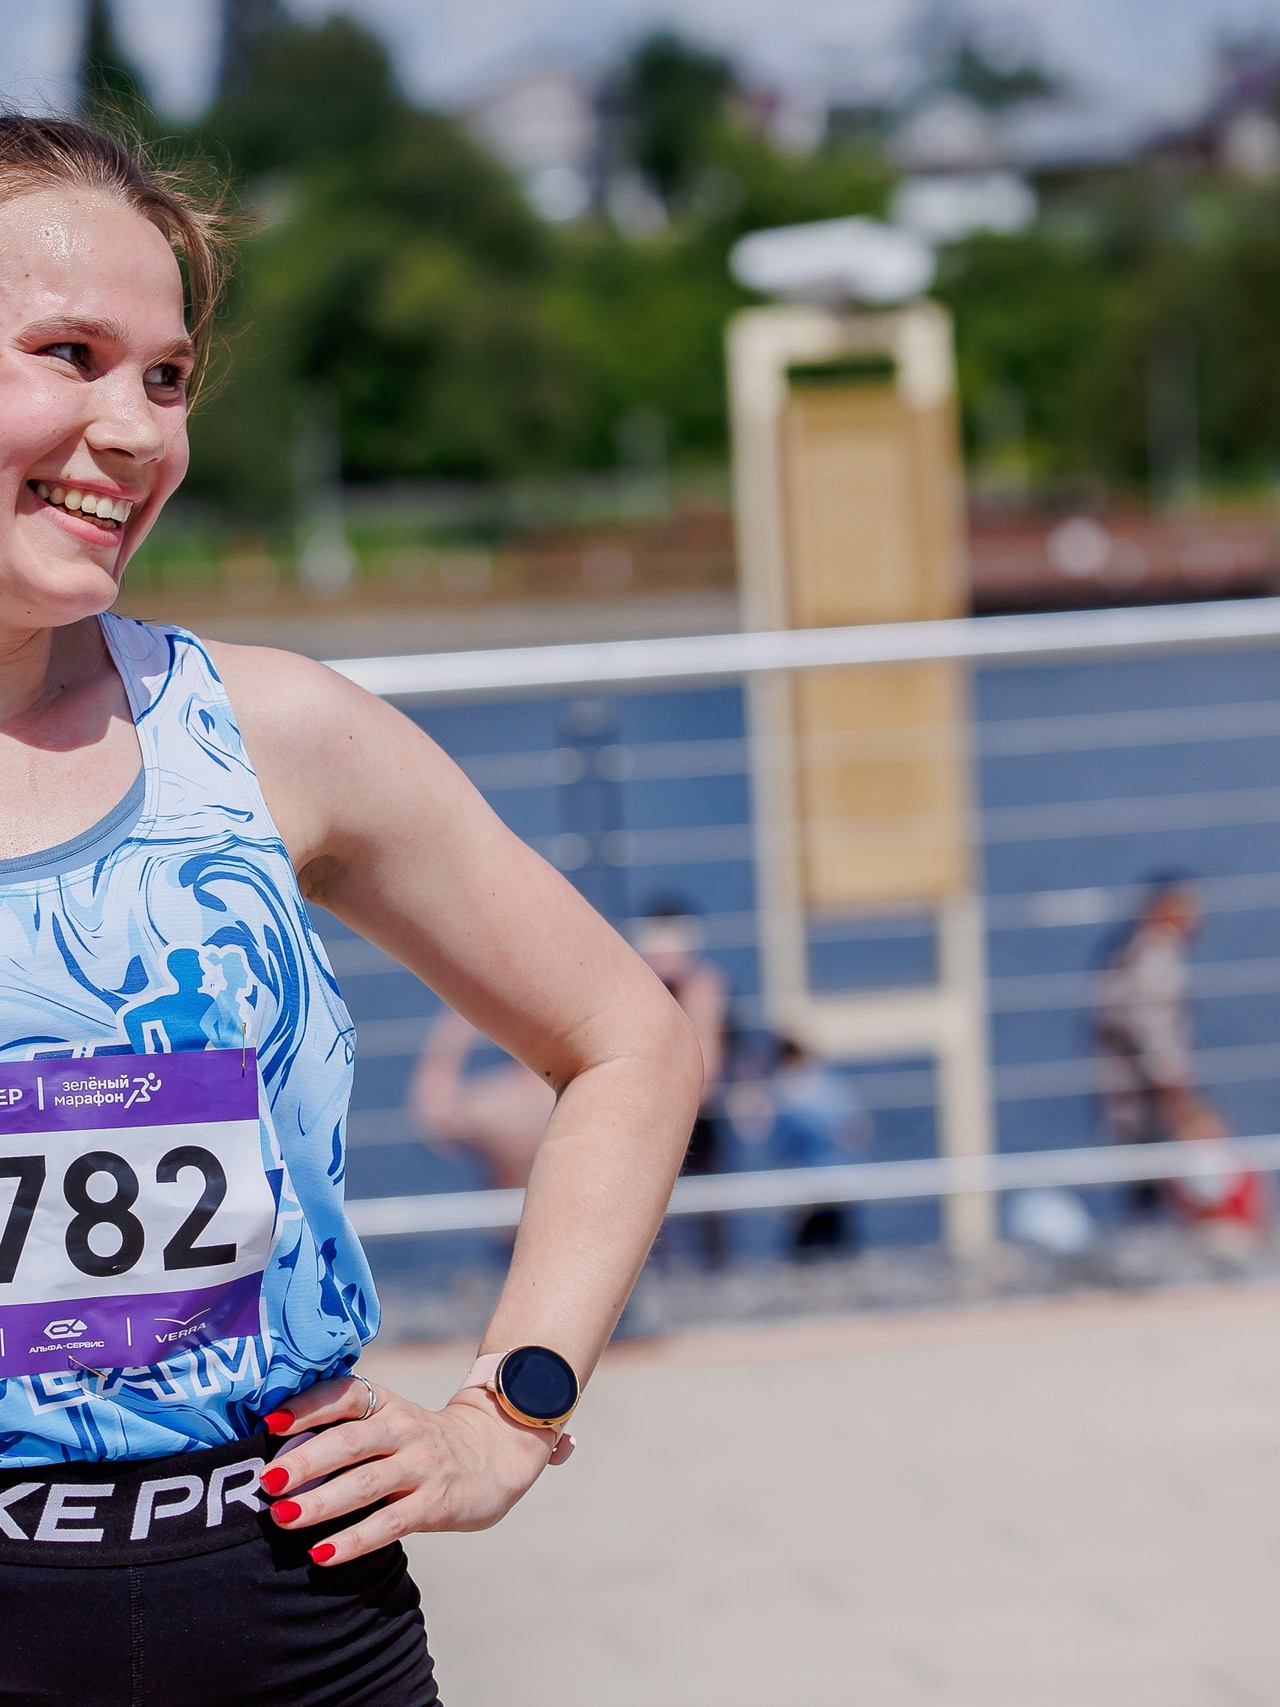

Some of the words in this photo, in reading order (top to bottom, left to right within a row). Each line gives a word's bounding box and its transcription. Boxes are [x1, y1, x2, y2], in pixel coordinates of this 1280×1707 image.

[62, 1074, 130, 1092] зелёный
[54, 1090, 124, 1108] марафон
[154, 1322, 207, 1344] VERRA
[28, 1341, 105, 1354] АЛЬФА-СЕРВИС
[130, 1436, 318, 1541] PR
